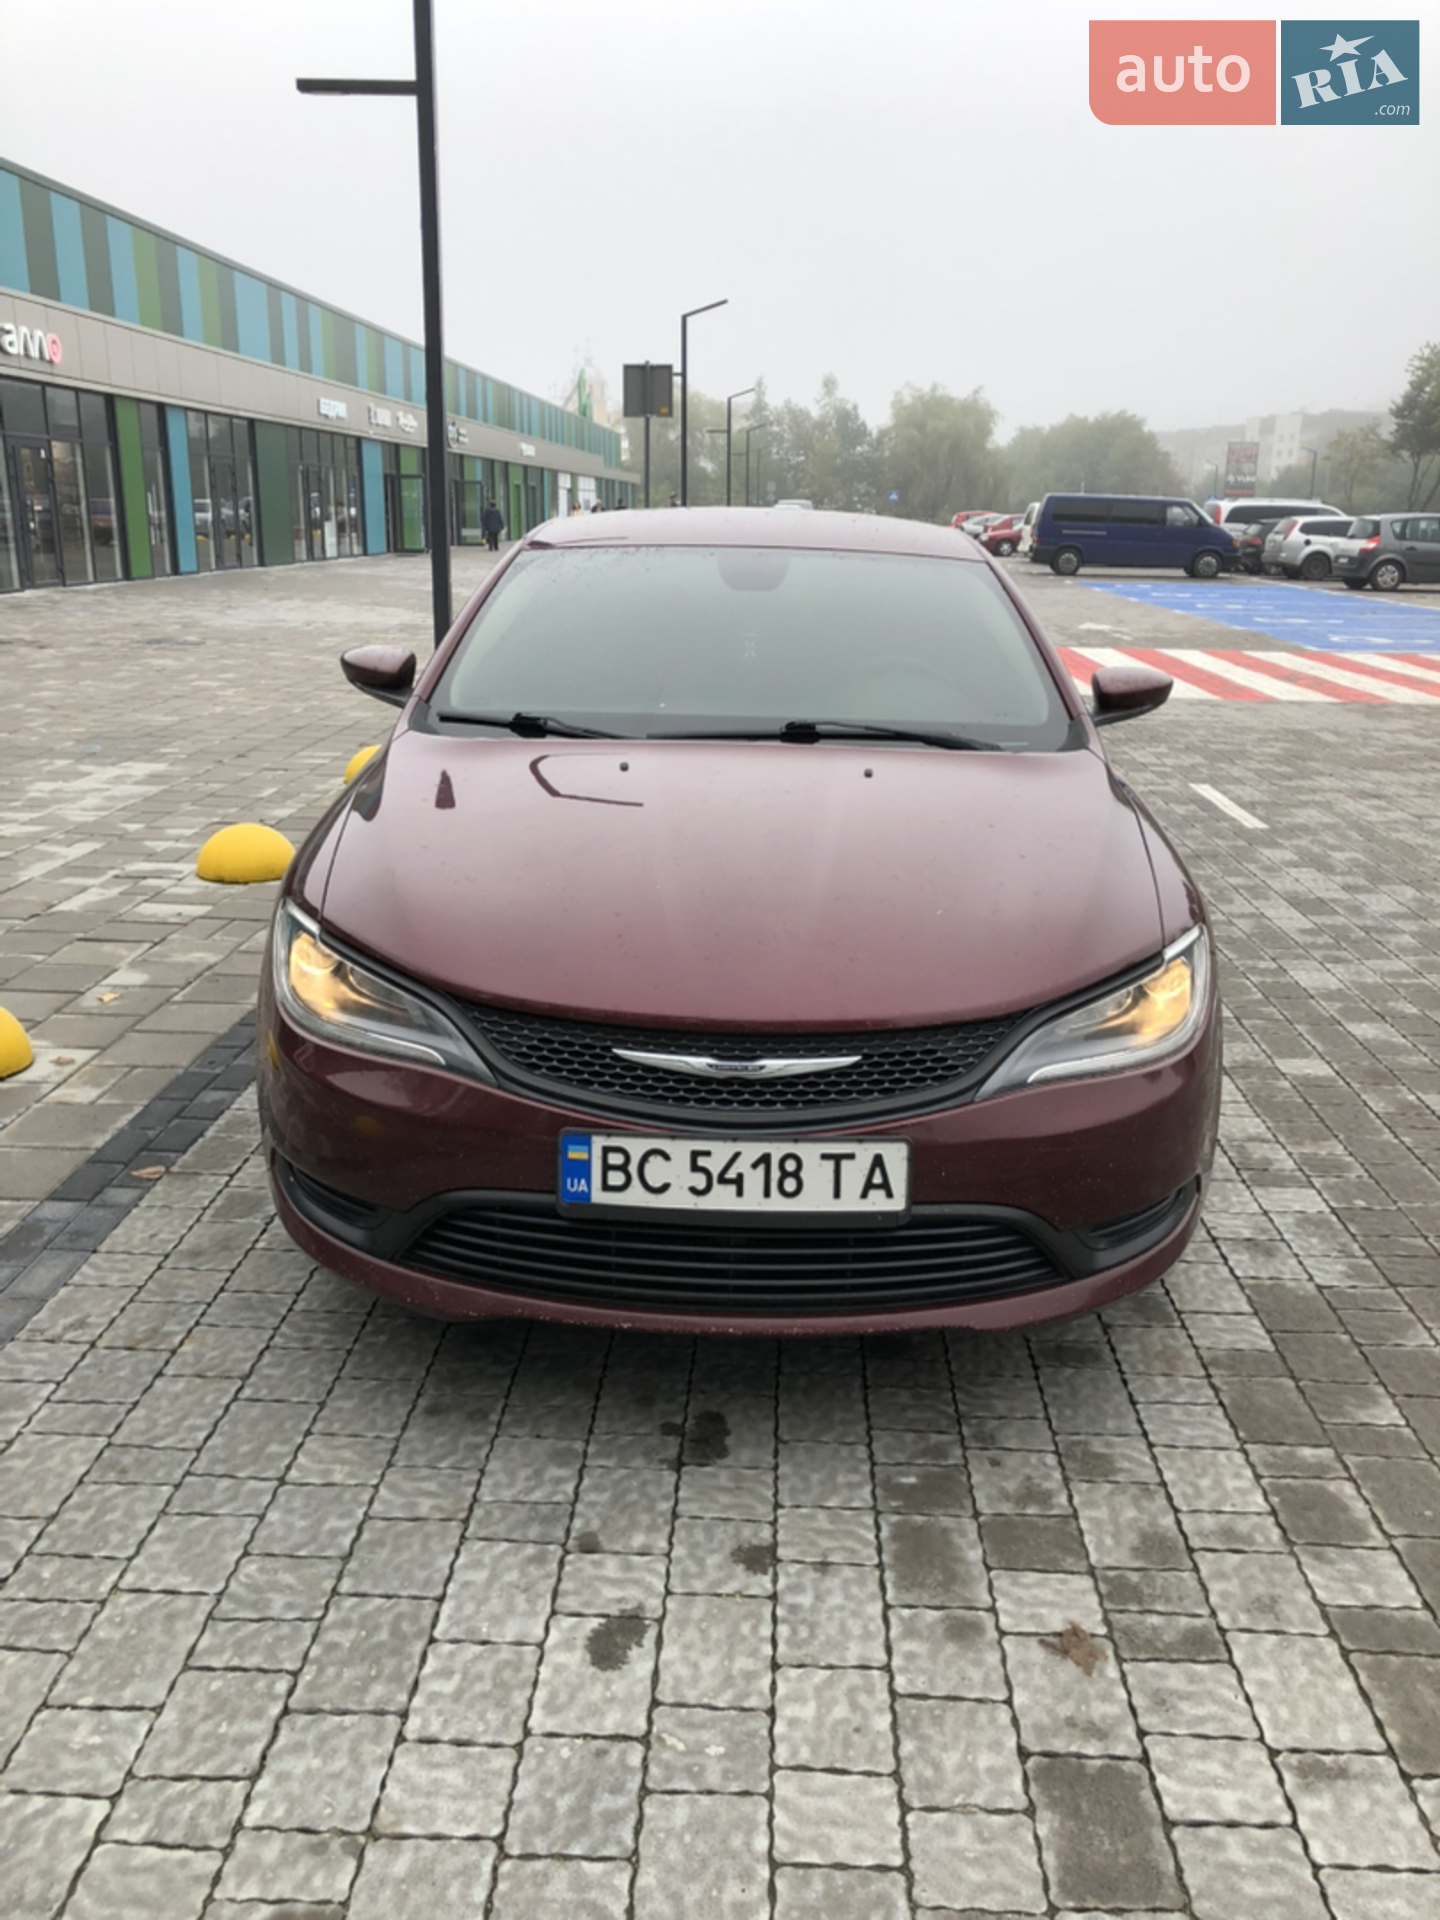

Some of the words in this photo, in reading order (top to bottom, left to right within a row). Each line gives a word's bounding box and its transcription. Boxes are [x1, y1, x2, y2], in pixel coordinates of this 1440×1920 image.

[566, 1177, 589, 1193] UA
[601, 1145, 672, 1195] BC
[688, 1150, 804, 1198] 5418
[820, 1152, 894, 1199] TA
